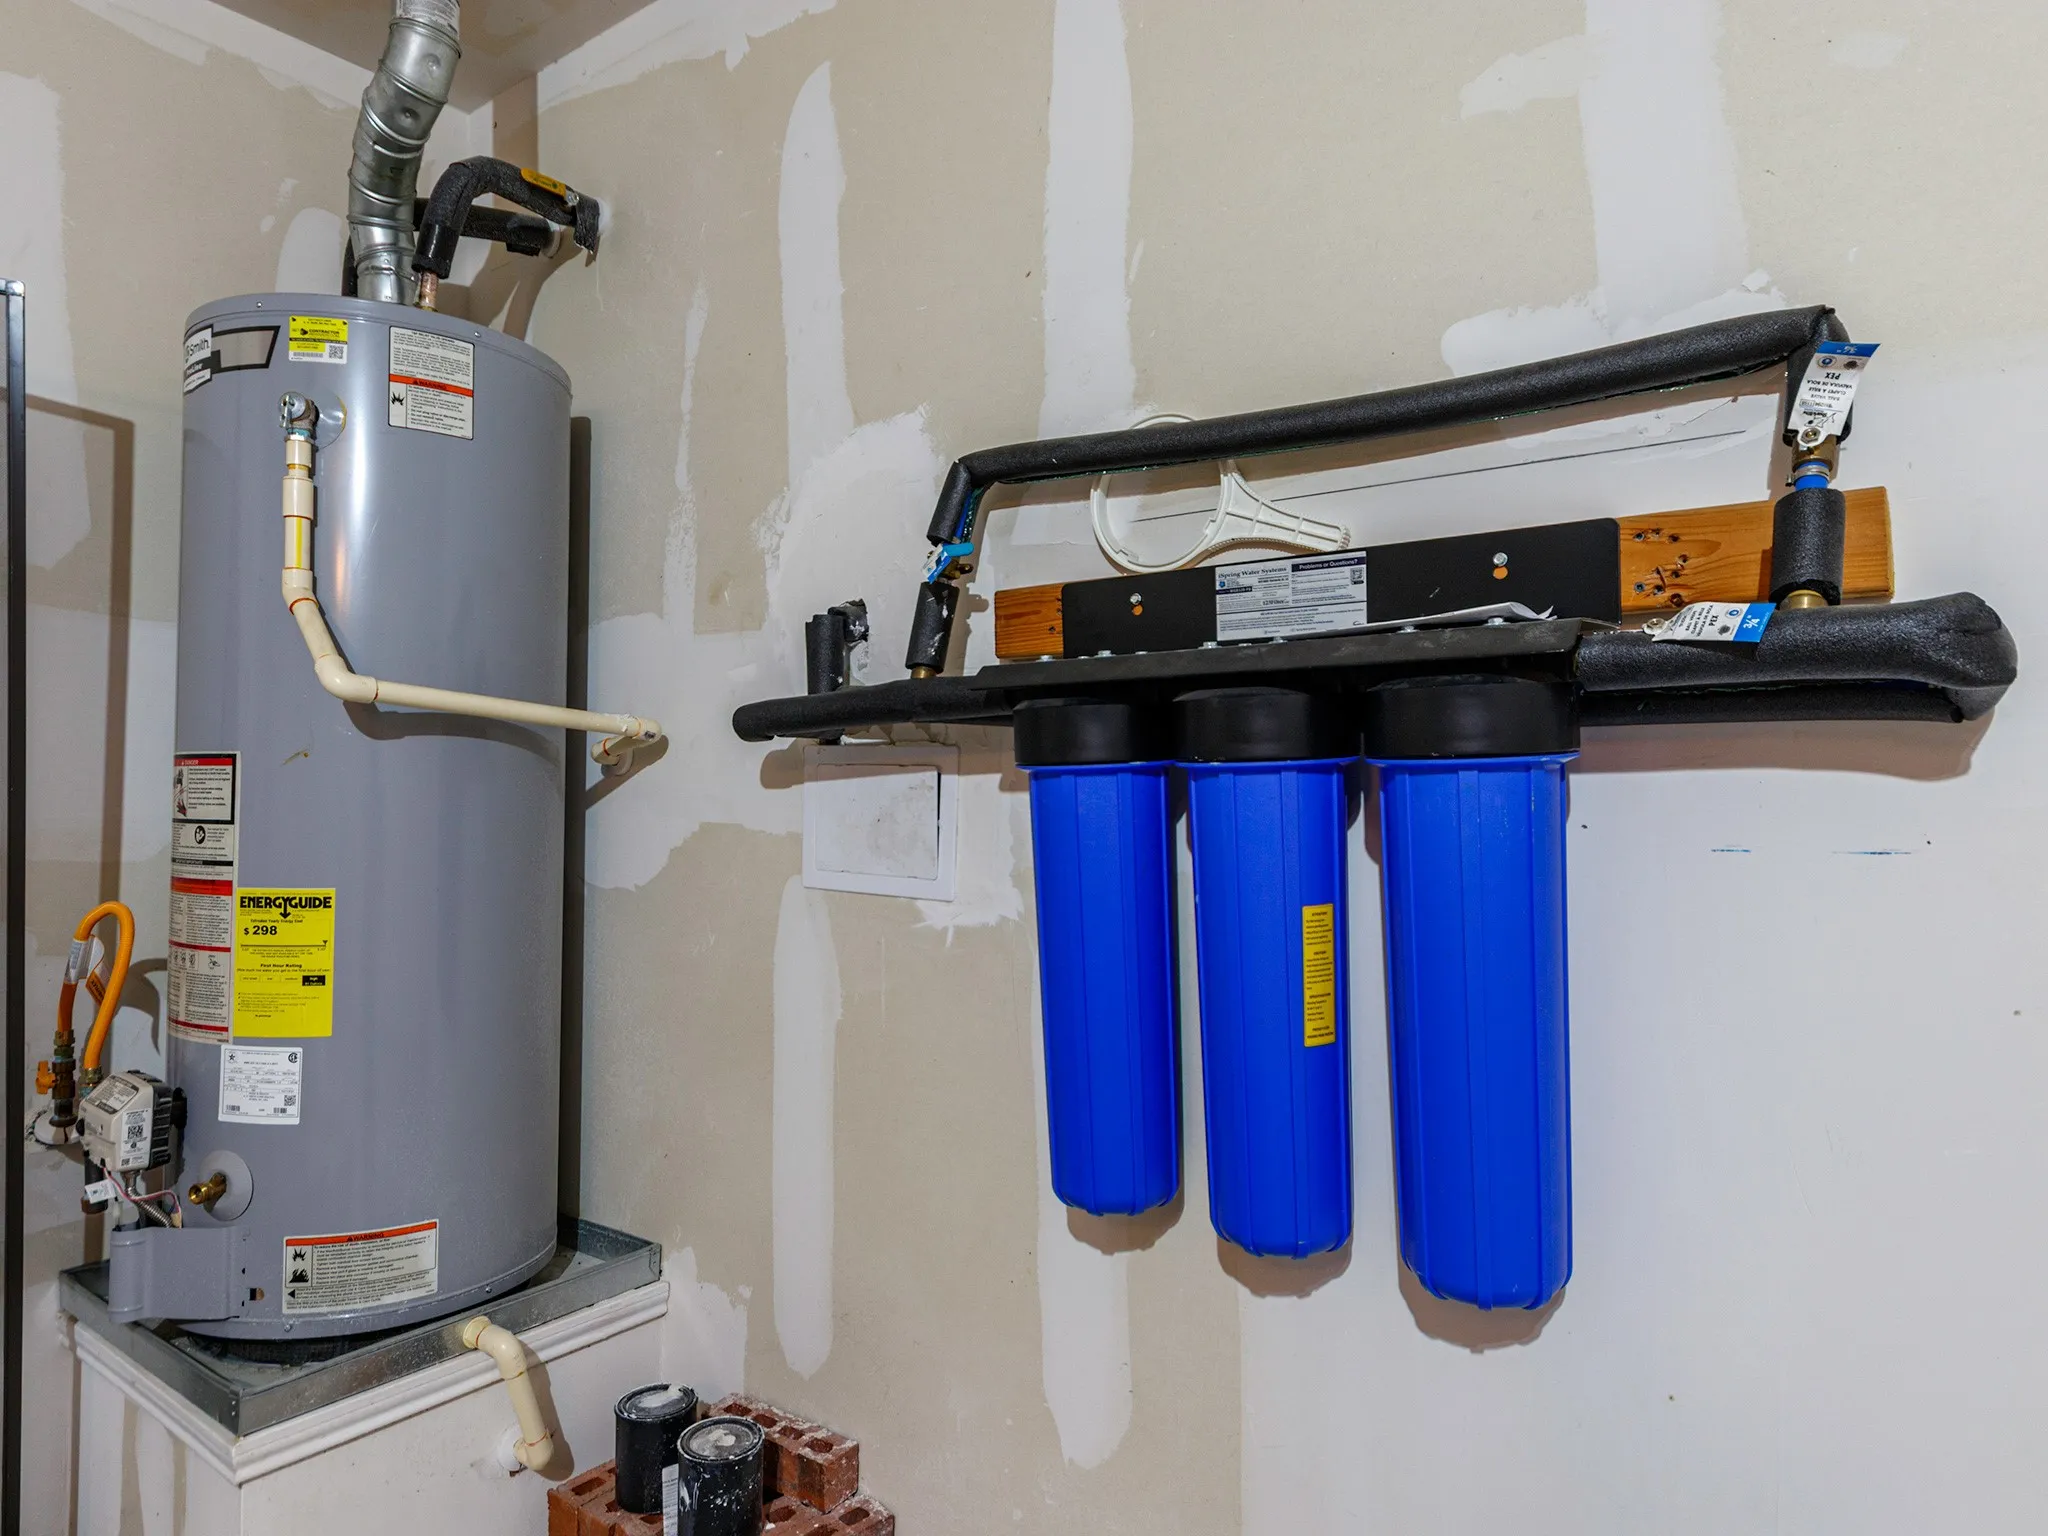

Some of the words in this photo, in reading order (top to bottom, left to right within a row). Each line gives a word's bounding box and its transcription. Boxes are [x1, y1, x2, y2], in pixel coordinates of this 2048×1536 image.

[190, 337, 209, 356] Smith
[1824, 372, 1842, 380] PEX
[1709, 615, 1719, 626] PEX
[240, 896, 332, 910] ENERGYGUIDE
[243, 927, 250, 936] $
[252, 925, 278, 936] 298
[353, 1232, 384, 1242] WARNING
